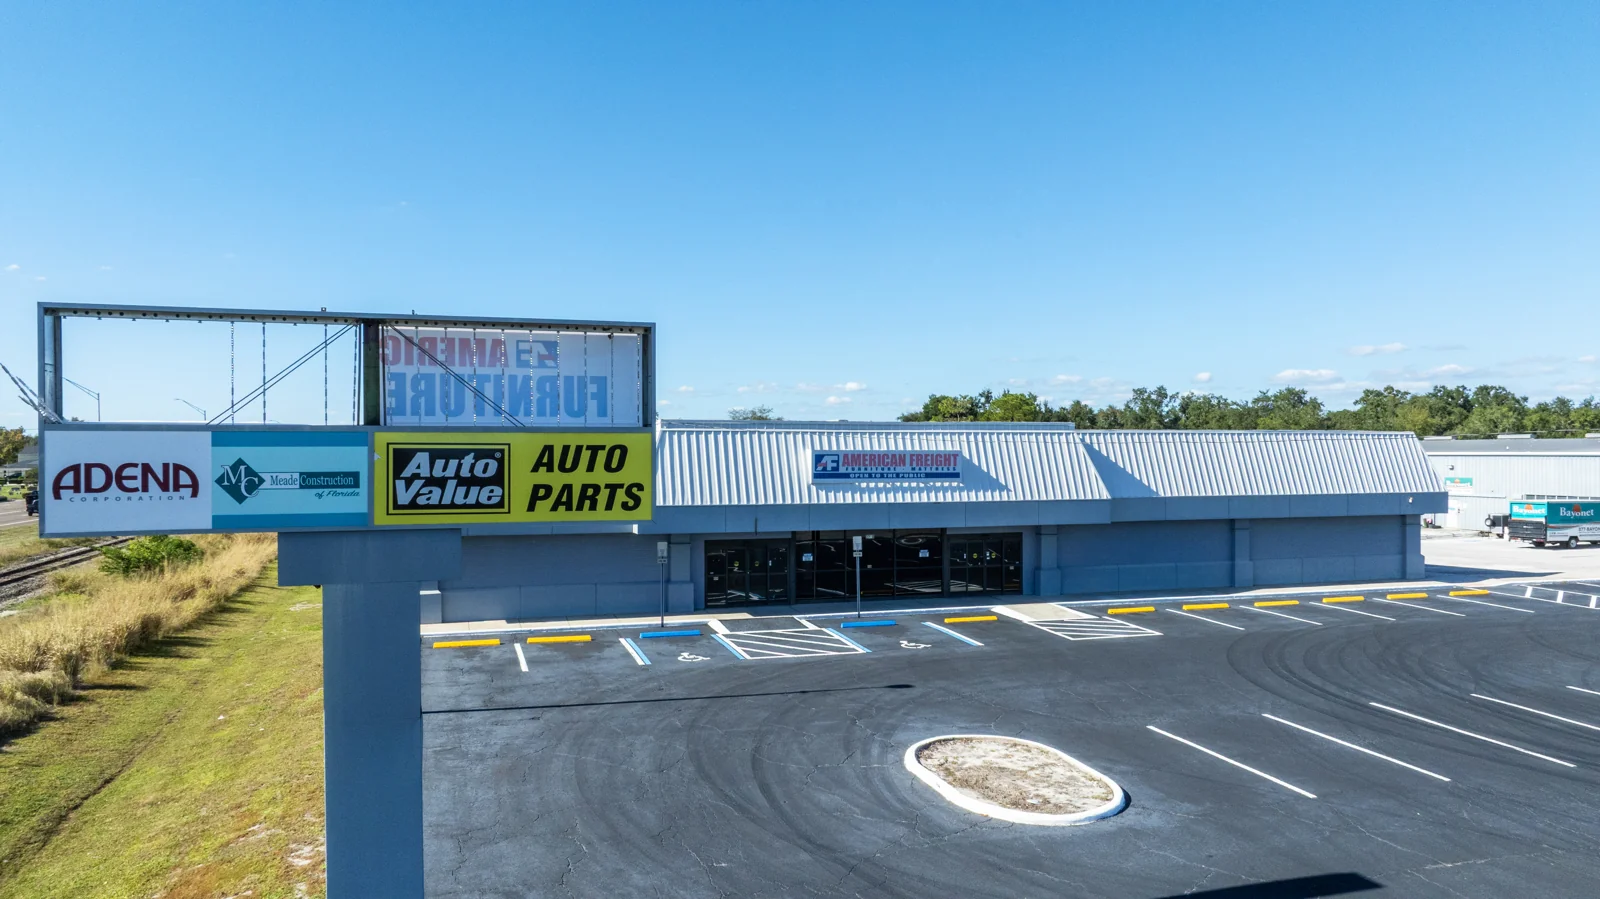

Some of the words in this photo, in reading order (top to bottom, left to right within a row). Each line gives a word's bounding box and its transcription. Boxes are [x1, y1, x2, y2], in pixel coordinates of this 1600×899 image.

[400, 451, 499, 478] Auto
[530, 444, 629, 473] AUTO
[842, 453, 907, 467] AMERICAN
[909, 453, 959, 467] FREIGHT
[52, 462, 200, 500] ADENA
[221, 465, 259, 498] MC
[270, 474, 298, 486] Meade
[300, 474, 354, 486] Construction
[69, 495, 185, 503] CORPORATION
[314, 491, 325, 500] of
[326, 490, 360, 498] Florida
[395, 479, 503, 506] Value
[526, 482, 645, 512] PARTS
[1512, 505, 1546, 515] Bayonet
[1560, 507, 1594, 518] Bayonet
